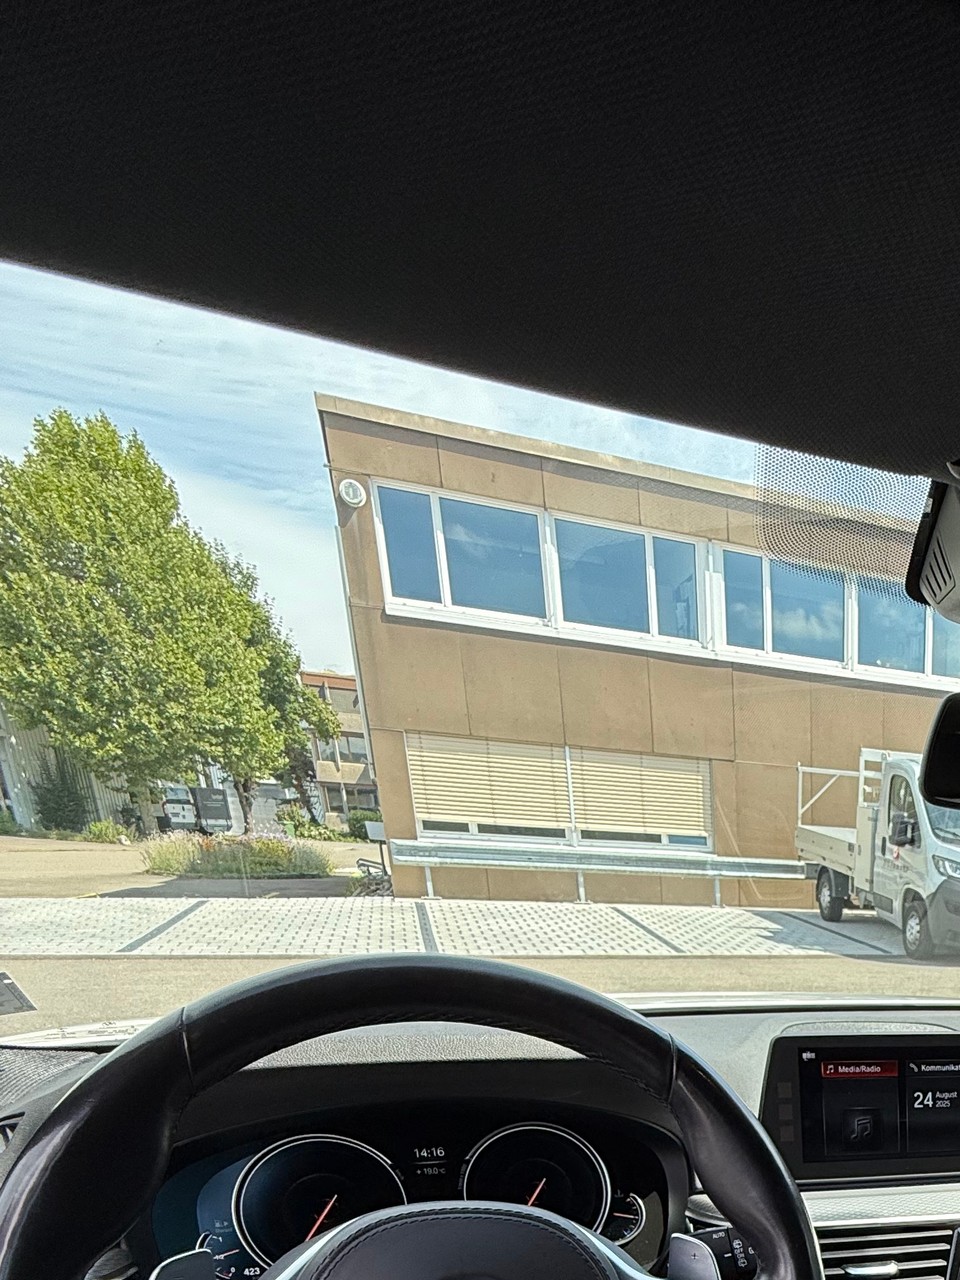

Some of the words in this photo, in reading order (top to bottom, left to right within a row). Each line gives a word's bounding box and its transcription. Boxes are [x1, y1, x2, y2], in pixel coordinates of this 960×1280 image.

[838, 1065, 881, 1073] Media/Radio
[913, 1091, 933, 1108] 24
[935, 1091, 958, 1099] August
[935, 1100, 951, 1108] 2025
[414, 1146, 445, 1158] 14:16
[713, 1231, 725, 1239] AUTO
[243, 1267, 260, 1276] 423
